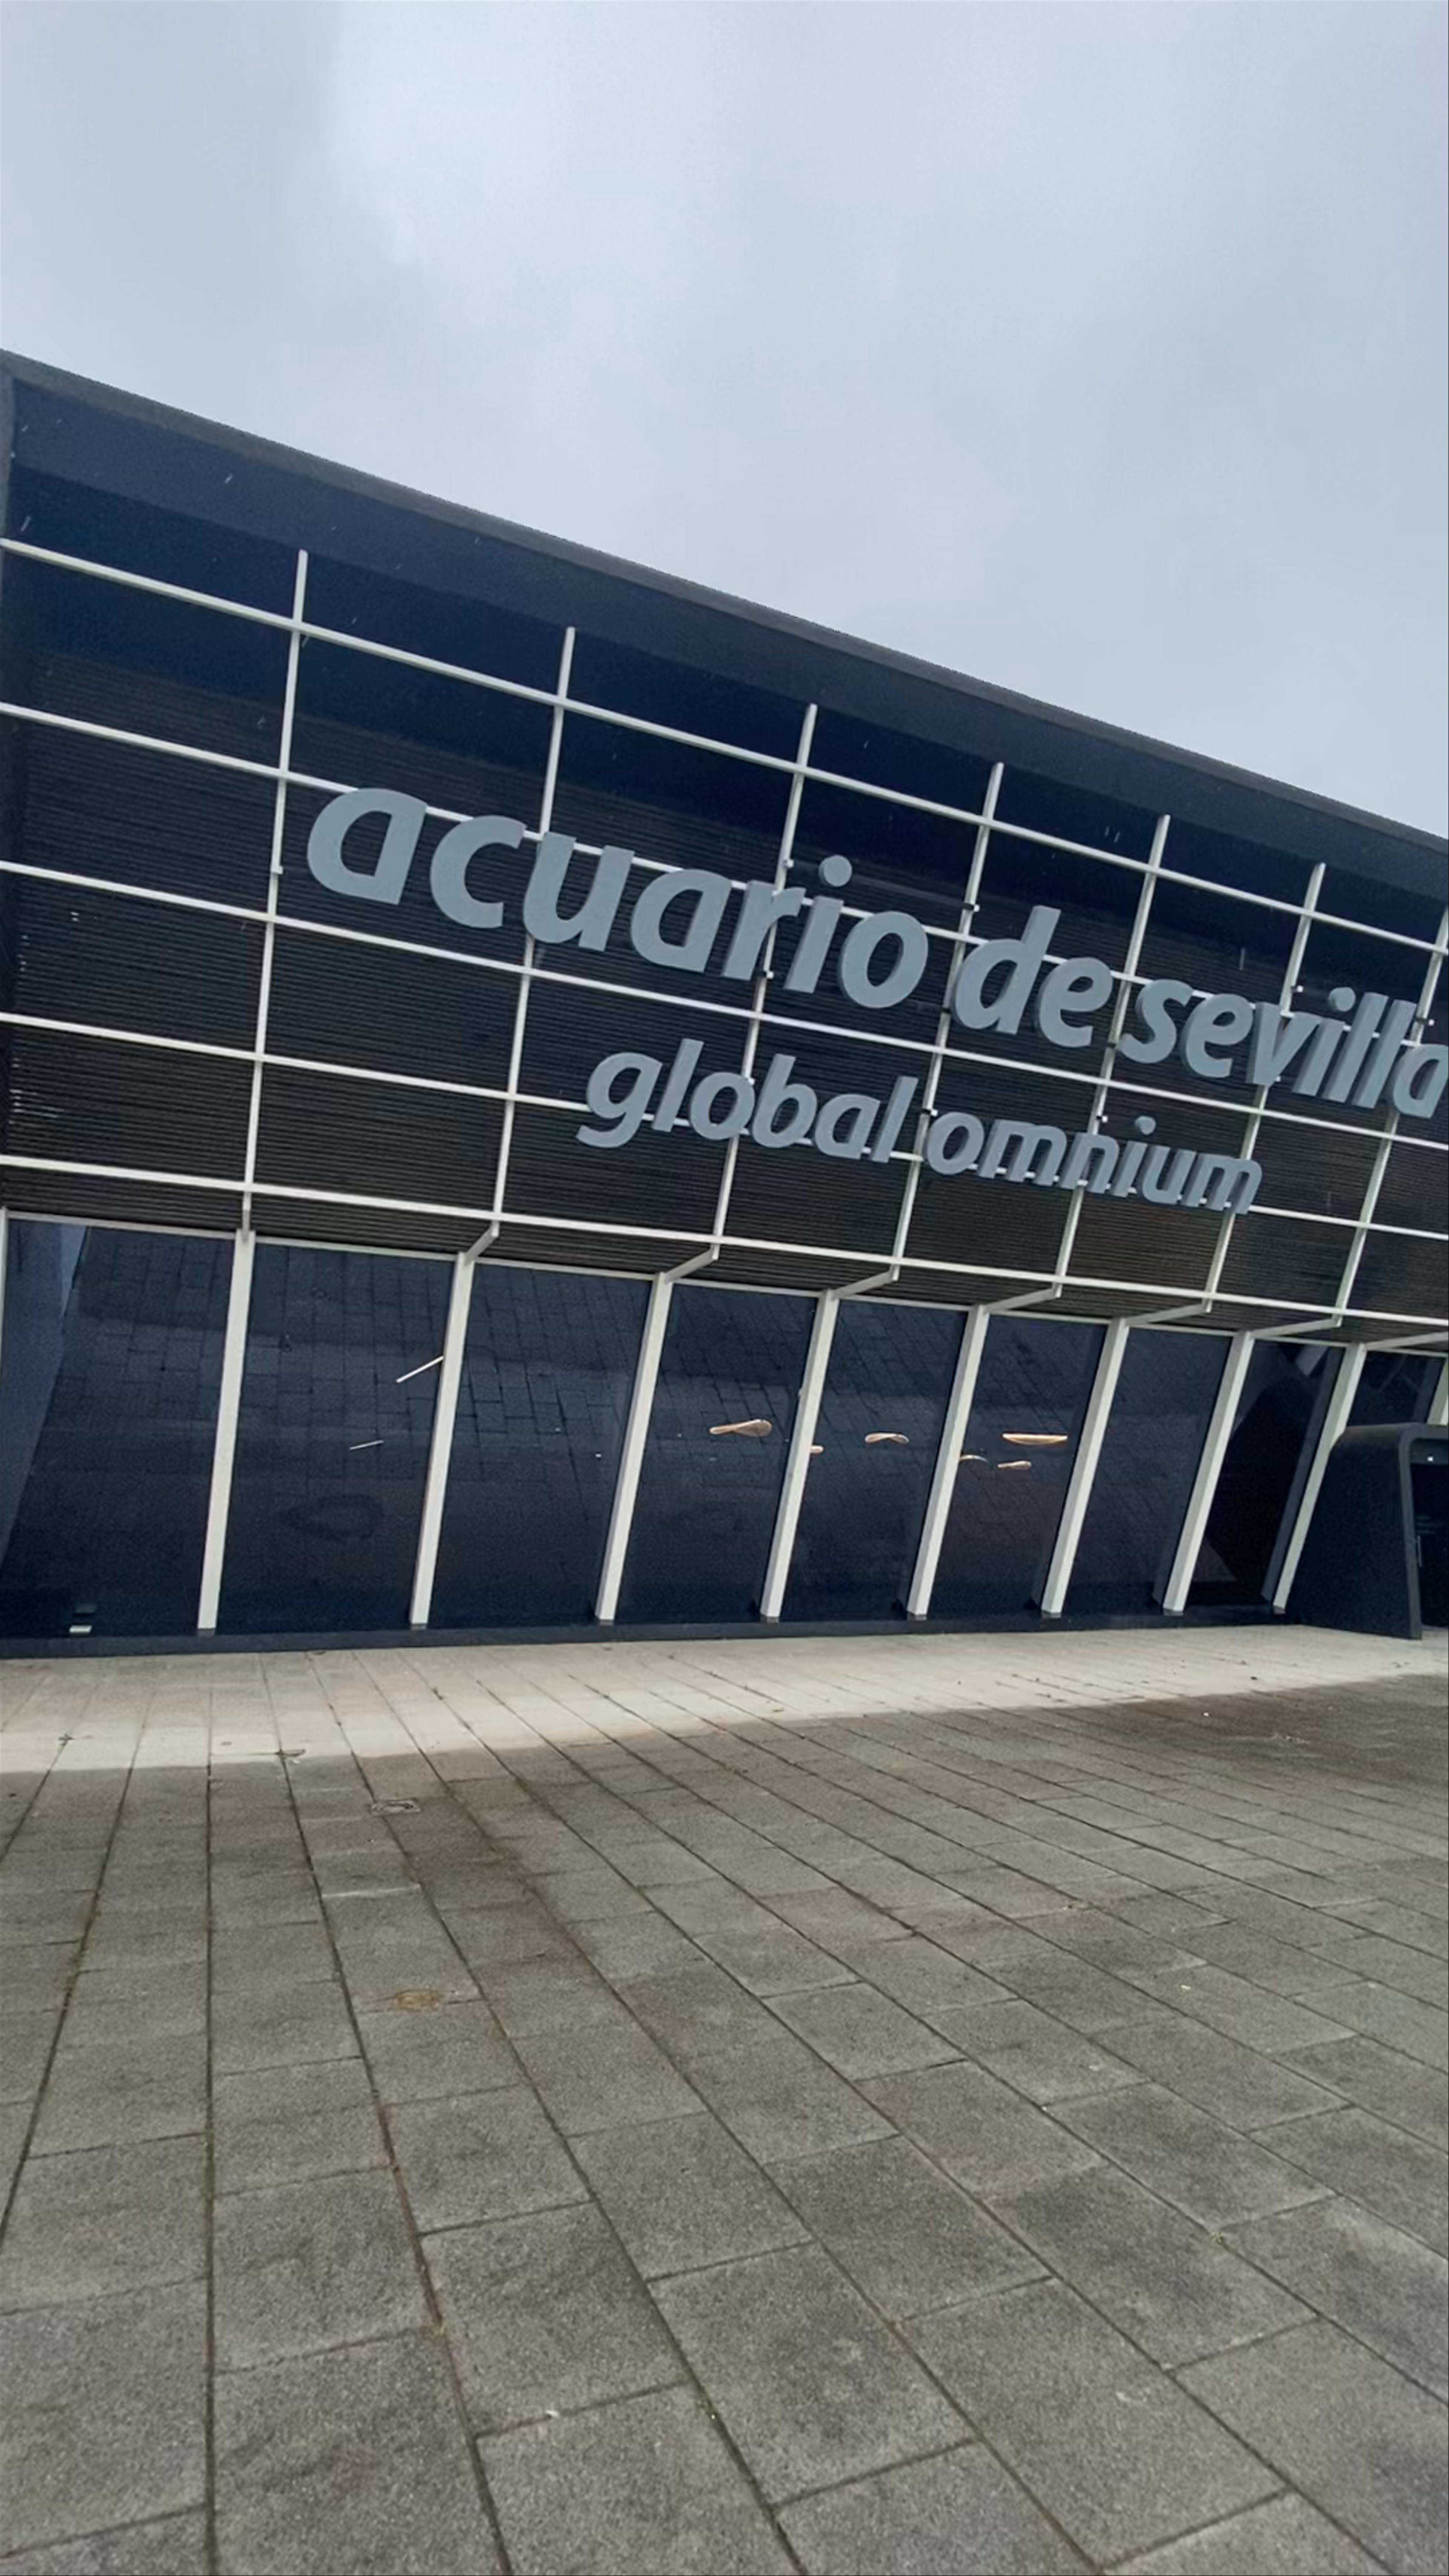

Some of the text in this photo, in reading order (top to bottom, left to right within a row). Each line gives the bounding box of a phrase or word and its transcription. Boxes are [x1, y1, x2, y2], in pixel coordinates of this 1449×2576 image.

[308, 788, 1449, 1118] acuario de sevilla
[576, 1038, 1263, 1215] global omnium
